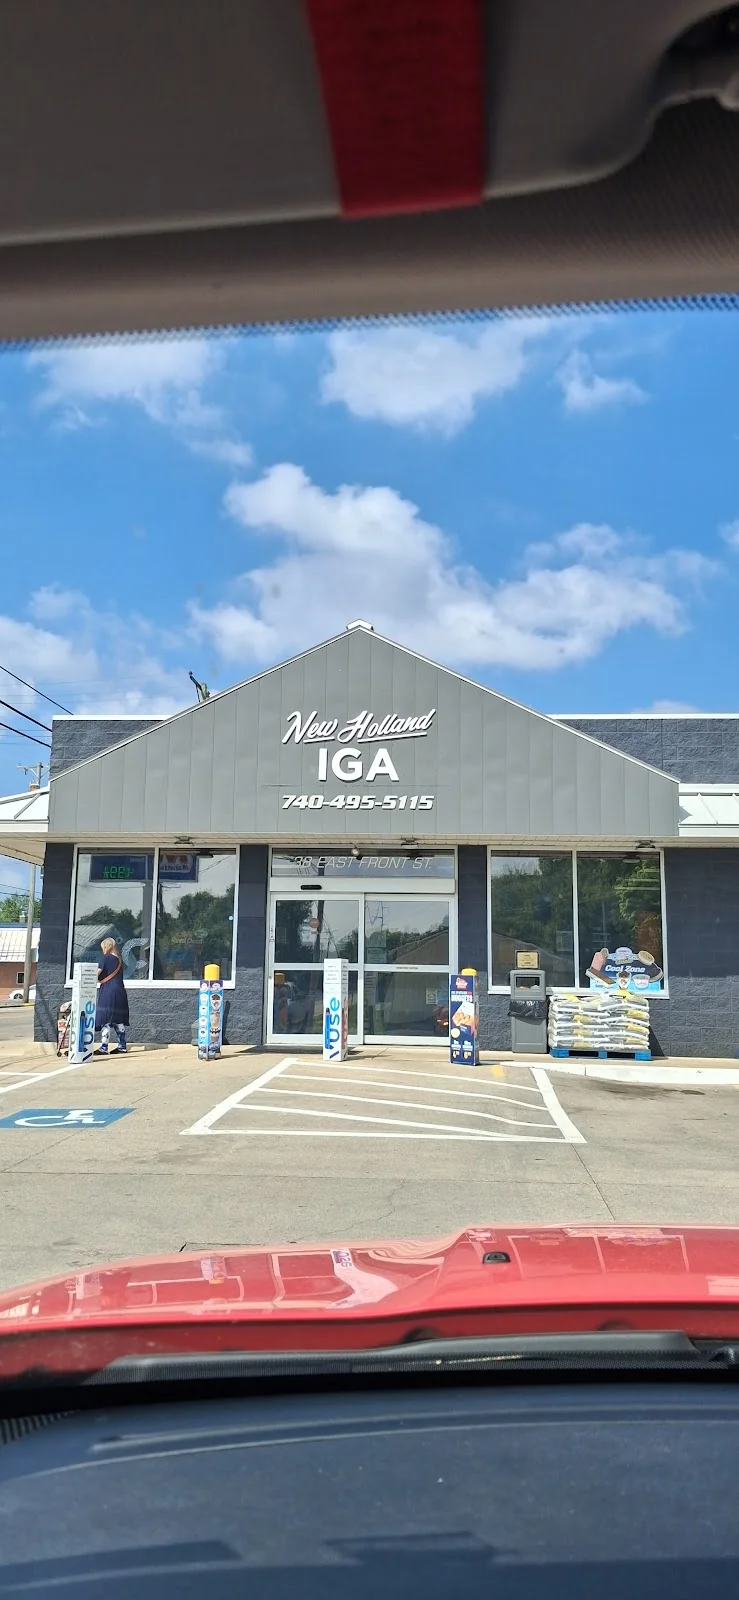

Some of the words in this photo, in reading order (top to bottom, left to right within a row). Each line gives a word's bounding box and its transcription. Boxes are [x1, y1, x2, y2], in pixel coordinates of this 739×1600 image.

[282, 710, 339, 743] New
[337, 708, 436, 743] Holland
[318, 747, 399, 782] IGA
[281, 794, 434, 810] 740-495-5115
[316, 856, 354, 868] EAST
[358, 856, 410, 869] FRONT
[412, 857, 434, 869] ST.
[625, 965, 646, 973] Zone
